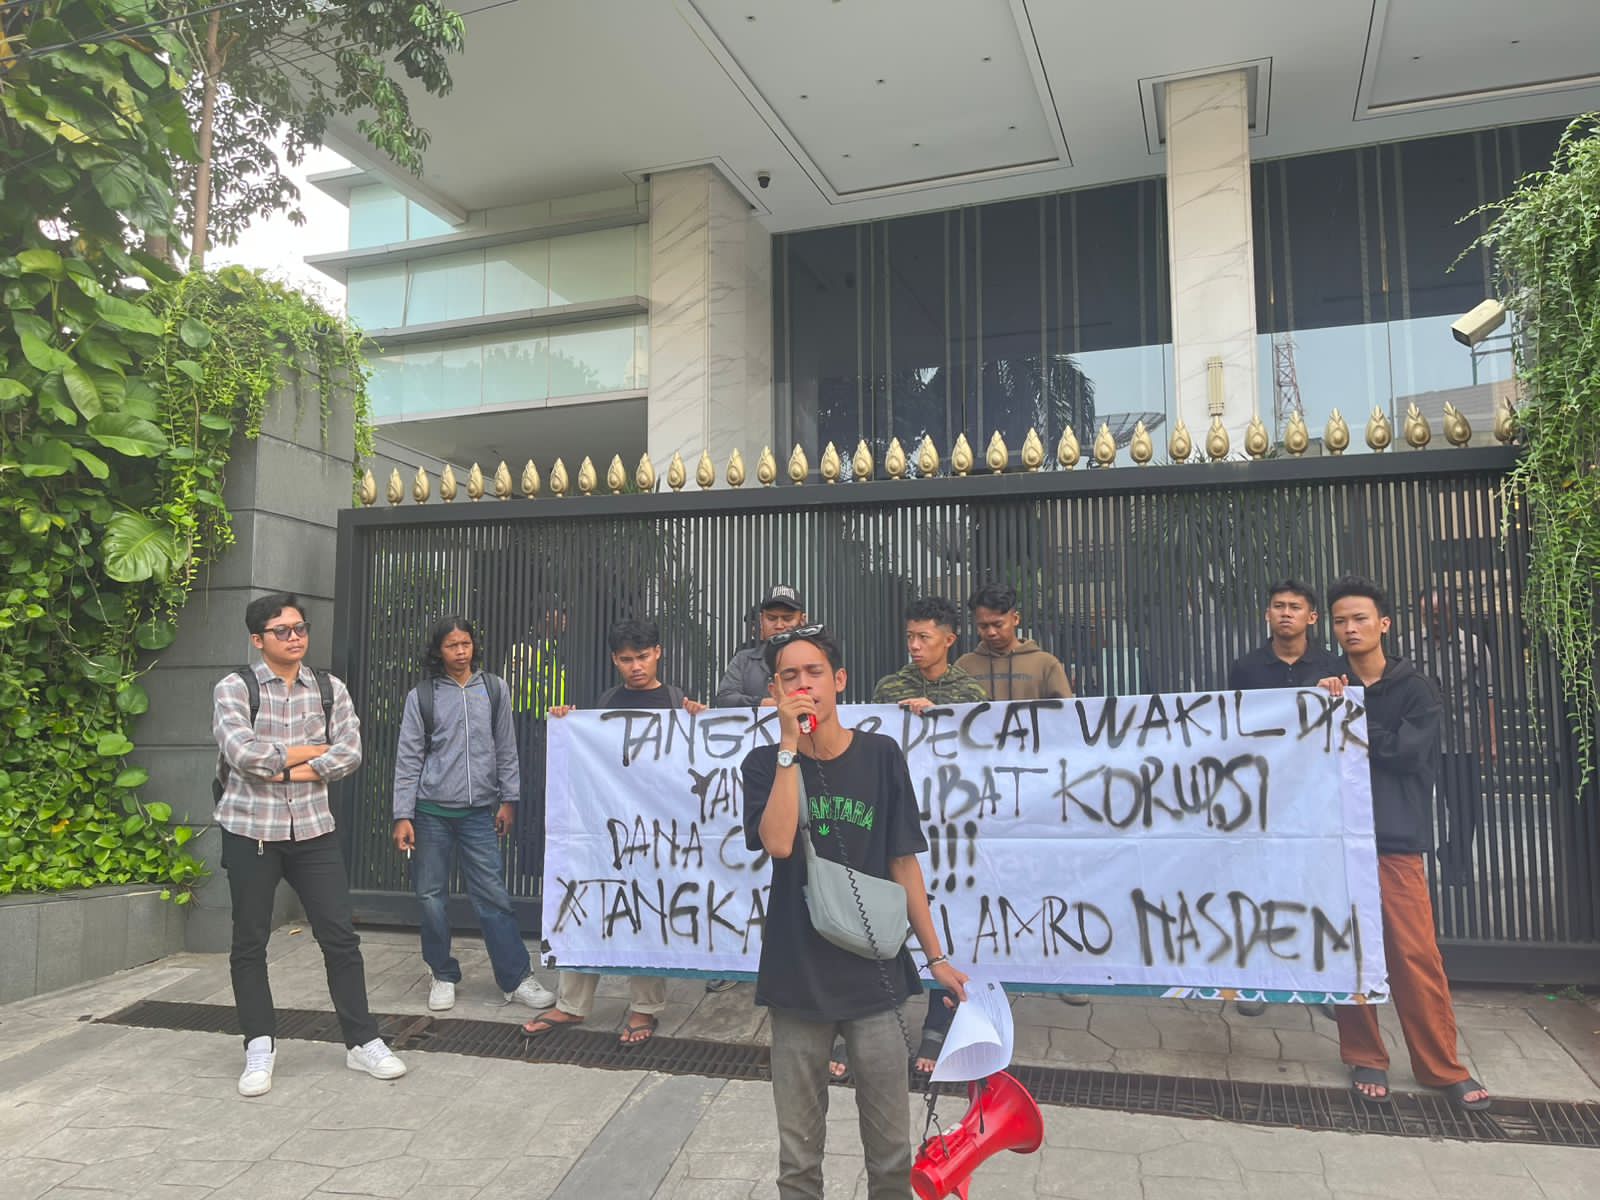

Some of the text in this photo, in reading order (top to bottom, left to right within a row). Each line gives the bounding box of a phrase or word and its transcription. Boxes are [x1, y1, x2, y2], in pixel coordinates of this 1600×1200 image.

[600, 709, 780, 767] TANGK
[900, 700, 1063, 761] PECAT
[1075, 691, 1286, 749] WAKIL
[687, 754, 1270, 832] YAN IBAT KORUPSI
[809, 794, 874, 832] ANTARA
[606, 815, 704, 872] DANA
[578, 876, 771, 955] TANGKA
[972, 893, 1113, 964] AMRO
[1130, 888, 1364, 994] NASDEM
